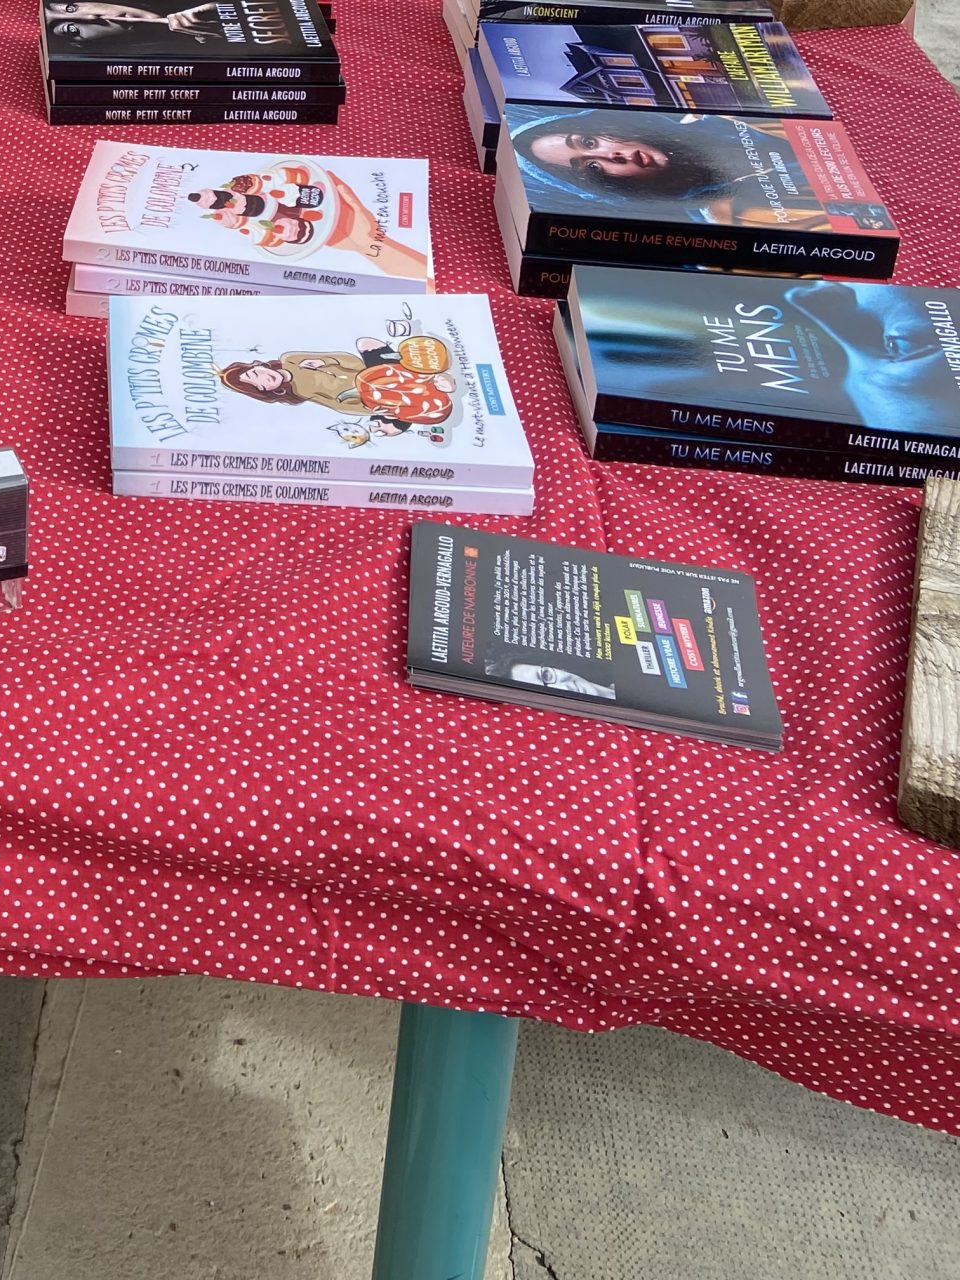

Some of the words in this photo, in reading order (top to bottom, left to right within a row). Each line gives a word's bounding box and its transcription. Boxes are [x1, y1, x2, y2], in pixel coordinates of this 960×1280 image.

[216, 3, 238, 20] PETIT
[524, 6, 579, 19] INCONSCIENT
[645, 14, 683, 25] LAETITIA
[685, 17, 721, 25] ARGOUD
[222, 22, 246, 43] NOTRE
[240, 0, 292, 45] SECRET
[298, 22, 322, 47] LAETITIA
[732, 26, 776, 64] ARTMAN
[503, 38, 520, 56] ARGOUD
[107, 65, 132, 76] NOTRE
[138, 66, 160, 76] PETIT
[164, 66, 194, 76] SECRET
[226, 67, 263, 77] LAETITIA
[266, 68, 300, 78] ARGOUD
[510, 56, 530, 77] LAETITIA
[717, 50, 749, 80] L'AFFAIRE
[112, 90, 138, 100] NOTRE
[144, 90, 166, 100] PETIT
[170, 90, 200, 100] SECRET
[232, 90, 268, 100] LAETITIA
[271, 91, 306, 100] ARGOUD
[750, 66, 798, 107] WILLIAM
[106, 110, 131, 120] NOTRE
[136, 110, 158, 120] PETIT
[162, 110, 192, 120] SECRET
[224, 110, 260, 120] LAETITIA
[262, 110, 298, 120] ARGOUD
[734, 121, 760, 160] REVIENNES
[810, 128, 833, 160] LECTEURS
[105, 150, 150, 183] CRIMES
[769, 152, 788, 174] ARGOUD
[144, 162, 184, 212] COLOMBINE
[370, 172, 389, 204] bouche
[756, 172, 770, 183] TU
[779, 174, 799, 195] LAETITIA
[831, 174, 845, 184] DE
[97, 184, 128, 212] P'TITS
[761, 184, 779, 200] QUE
[837, 184, 854, 199] PLUS
[140, 214, 171, 228] DE
[376, 205, 390, 218] en
[770, 201, 790, 224] POUR
[99, 216, 133, 234] LES
[374, 220, 388, 243] mort
[549, 226, 586, 240] POUR
[590, 230, 620, 242] QUE
[624, 232, 639, 243] TU
[642, 233, 663, 245] ME
[666, 235, 738, 251] REVIENNES
[366, 244, 382, 258] La
[753, 242, 806, 256] LAETITIA
[810, 246, 875, 262] ARGOUD
[115, 248, 130, 261] LES
[132, 251, 157, 264] P'TITS
[160, 254, 189, 268] CRIMES
[192, 257, 202, 270] DE
[204, 259, 250, 276] COLOMBINE
[126, 278, 140, 291] LES
[142, 281, 167, 294] P'TITS
[170, 284, 199, 295] CRIMES
[202, 286, 212, 296] DE
[283, 270, 316, 284] LAETITIA
[319, 275, 356, 288] ARGOUD
[128, 305, 179, 364] CRIMES
[703, 316, 740, 347] ME
[408, 342, 424, 368] LAETITIA
[424, 339, 440, 370] ARGOUD
[444, 318, 474, 380] d'Halloween
[734, 303, 810, 394] MENS
[180, 328, 218, 403] COLOMBINE
[713, 351, 748, 372] TU
[128, 368, 168, 410] P'TITS
[186, 406, 220, 424] DE
[465, 382, 485, 436] mort-vivant
[141, 412, 189, 442] LES
[670, 409, 690, 424] TU
[695, 413, 722, 428] ME
[726, 417, 774, 434] MENS
[473, 437, 486, 448] Le
[848, 434, 900, 451] LAETITIA
[170, 452, 188, 466] LES
[191, 454, 220, 469] P'TITS
[223, 456, 258, 470] CRIMES
[261, 458, 274, 471] DE
[276, 459, 330, 474] COLOMBINE
[670, 444, 690, 458] TU
[694, 447, 721, 462] ME
[724, 450, 772, 465] MENS
[370, 464, 408, 478] LAETITIA
[411, 467, 454, 480] ARGOUD
[844, 462, 894, 477] LAETITIA
[170, 480, 188, 494] LES
[191, 481, 220, 496] P'TITS
[222, 484, 258, 498] CRIMES
[260, 486, 273, 498] DE
[276, 486, 330, 501] COLOMBINE
[368, 492, 408, 505] LAETITIA
[410, 494, 454, 507] ARGOUD
[629, 562, 660, 572] PUBLIQUE
[434, 536, 454, 625] ARGOUD-VERNAGALLO
[464, 560, 477, 611] NARBONNE
[630, 594, 646, 628] SURNATUREL
[702, 588, 712, 614] amazon
[463, 610, 476, 624] DE
[652, 602, 668, 630] JEUNESSE
[621, 620, 632, 640] POLAR
[678, 623, 692, 650] MYSTERY
[432, 626, 449, 664] LAETITIA
[462, 624, 475, 664] AUTEURE
[662, 640, 673, 656] VRAIE
[641, 646, 654, 670] THRILLER
[686, 650, 698, 666] COSY
[667, 656, 681, 684] HISTOIRE
